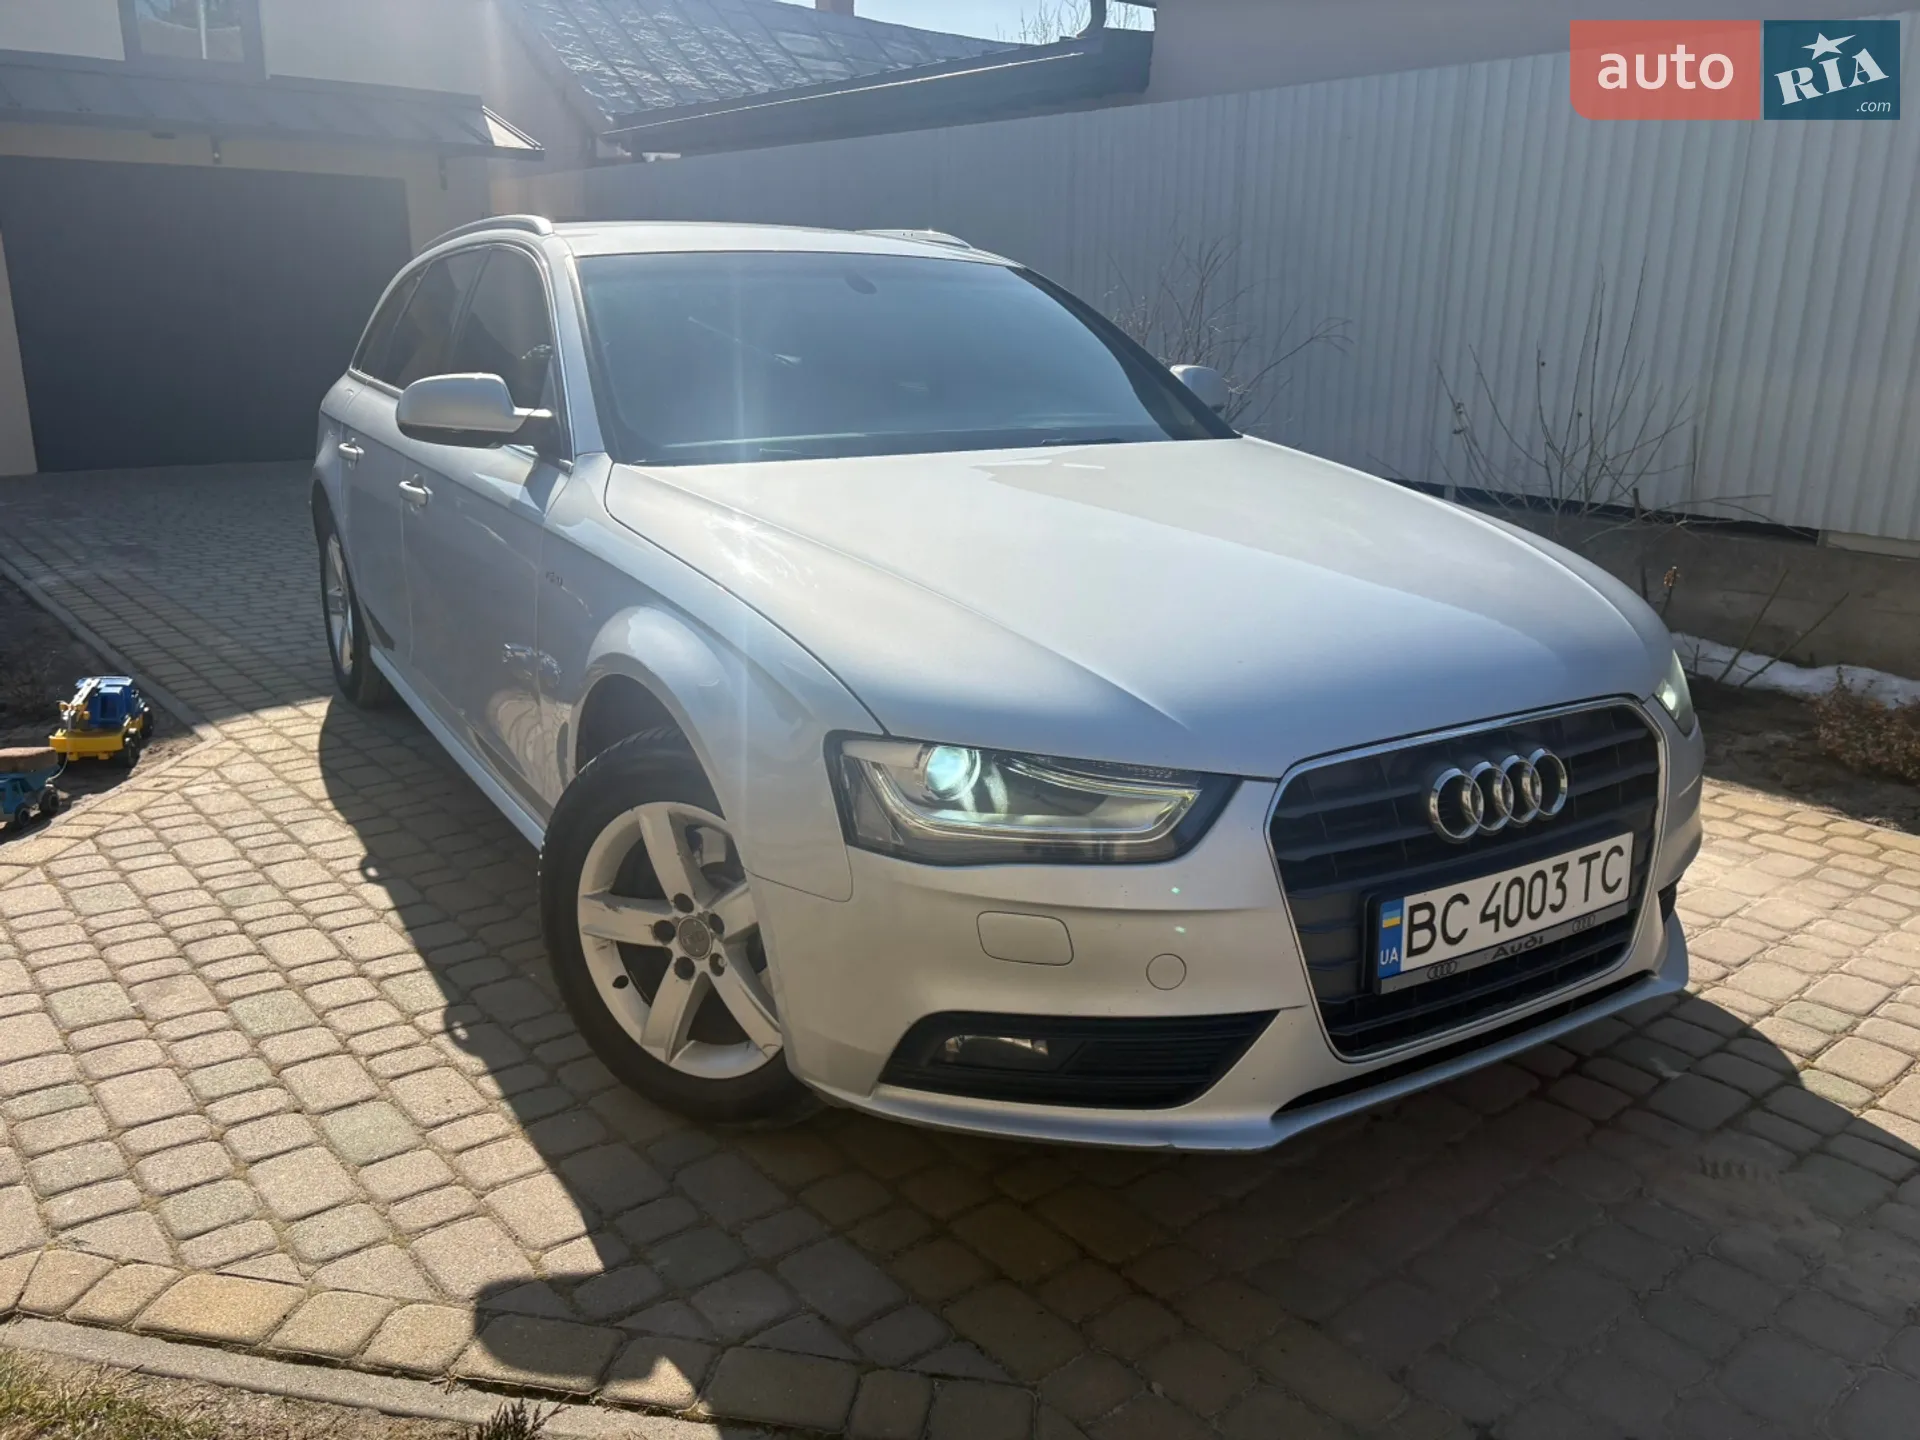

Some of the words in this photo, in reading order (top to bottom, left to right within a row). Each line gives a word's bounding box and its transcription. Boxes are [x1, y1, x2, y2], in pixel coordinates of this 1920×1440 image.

[1407, 893, 1469, 958] BC
[1479, 861, 1568, 933] 4003
[1578, 845, 1624, 903] TC
[1380, 947, 1399, 965] UA
[1492, 935, 1543, 960] Audi
